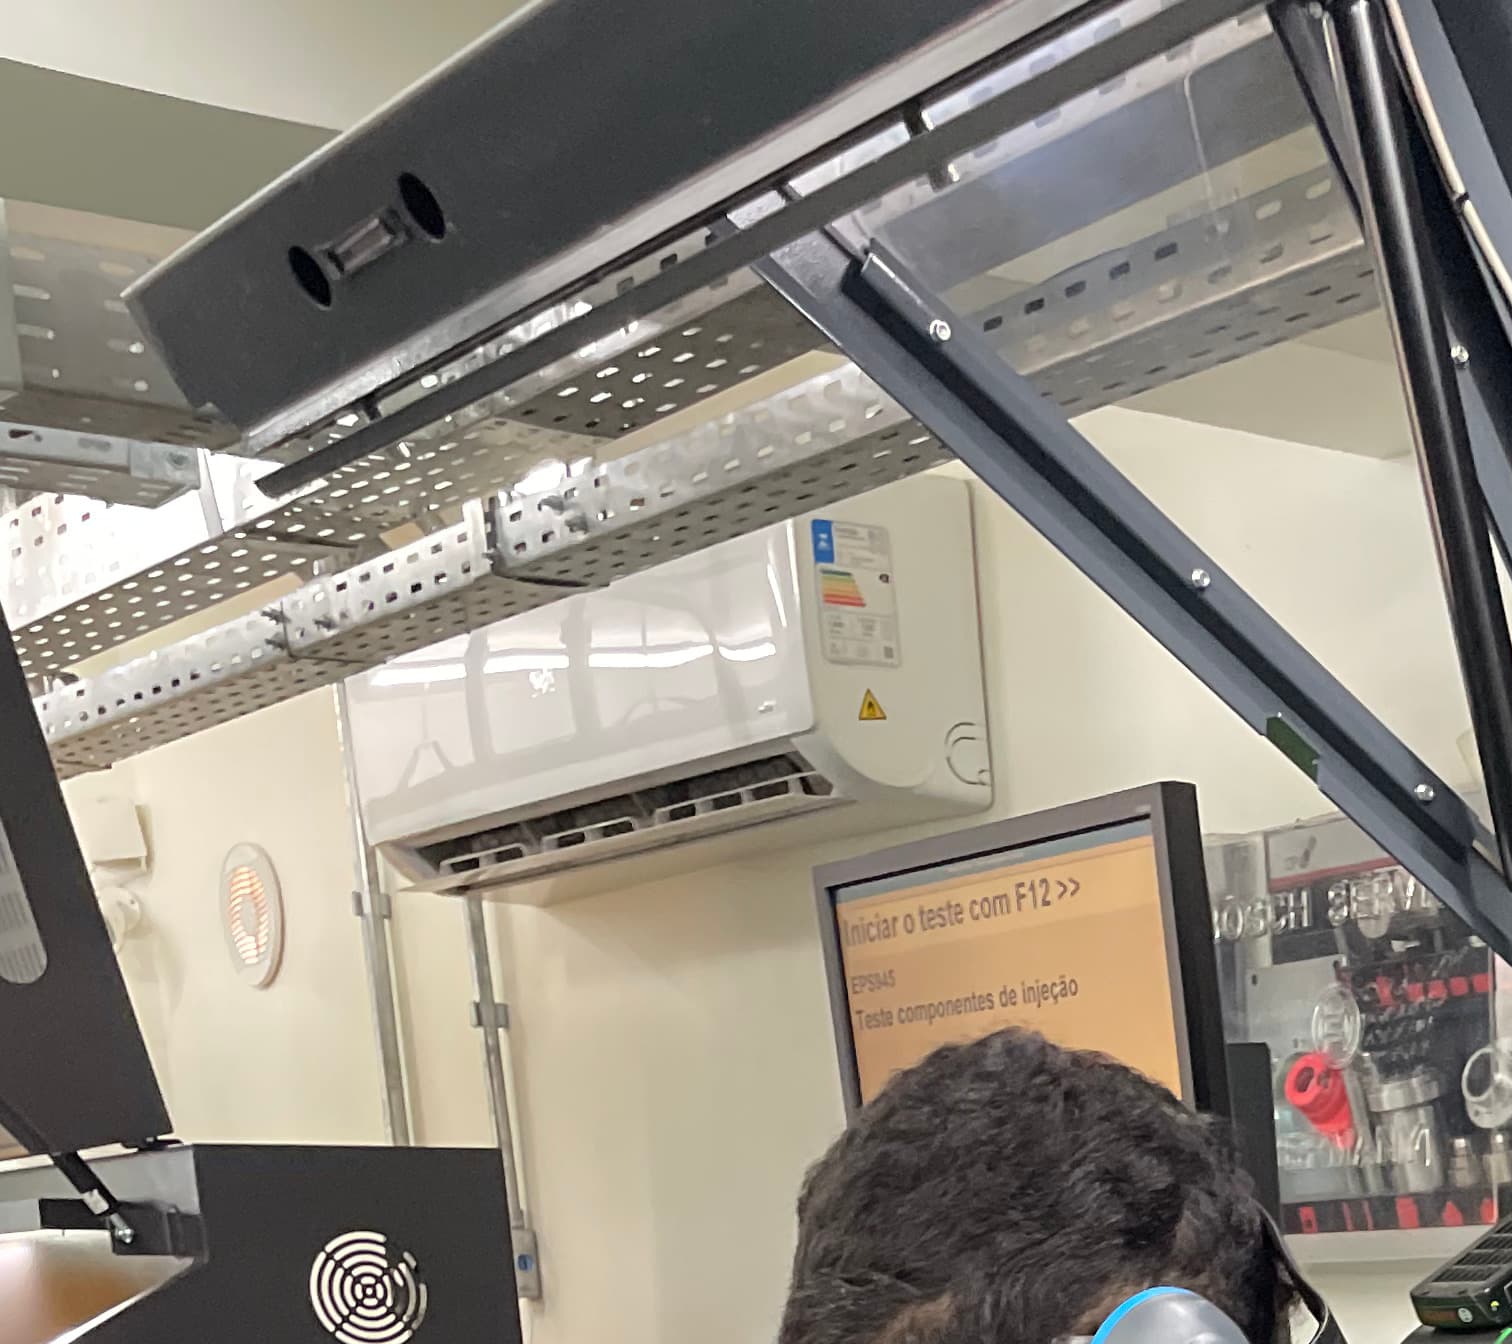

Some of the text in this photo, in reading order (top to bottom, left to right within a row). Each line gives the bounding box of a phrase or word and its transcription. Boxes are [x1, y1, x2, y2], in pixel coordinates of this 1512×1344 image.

[843, 912, 899, 947] Iniciar
[903, 914, 916, 936] o
[919, 899, 965, 932] teste
[968, 891, 1011, 922] com
[1015, 877, 1052, 912] F12
[856, 974, 1080, 1031] Teste componentes de injeção
